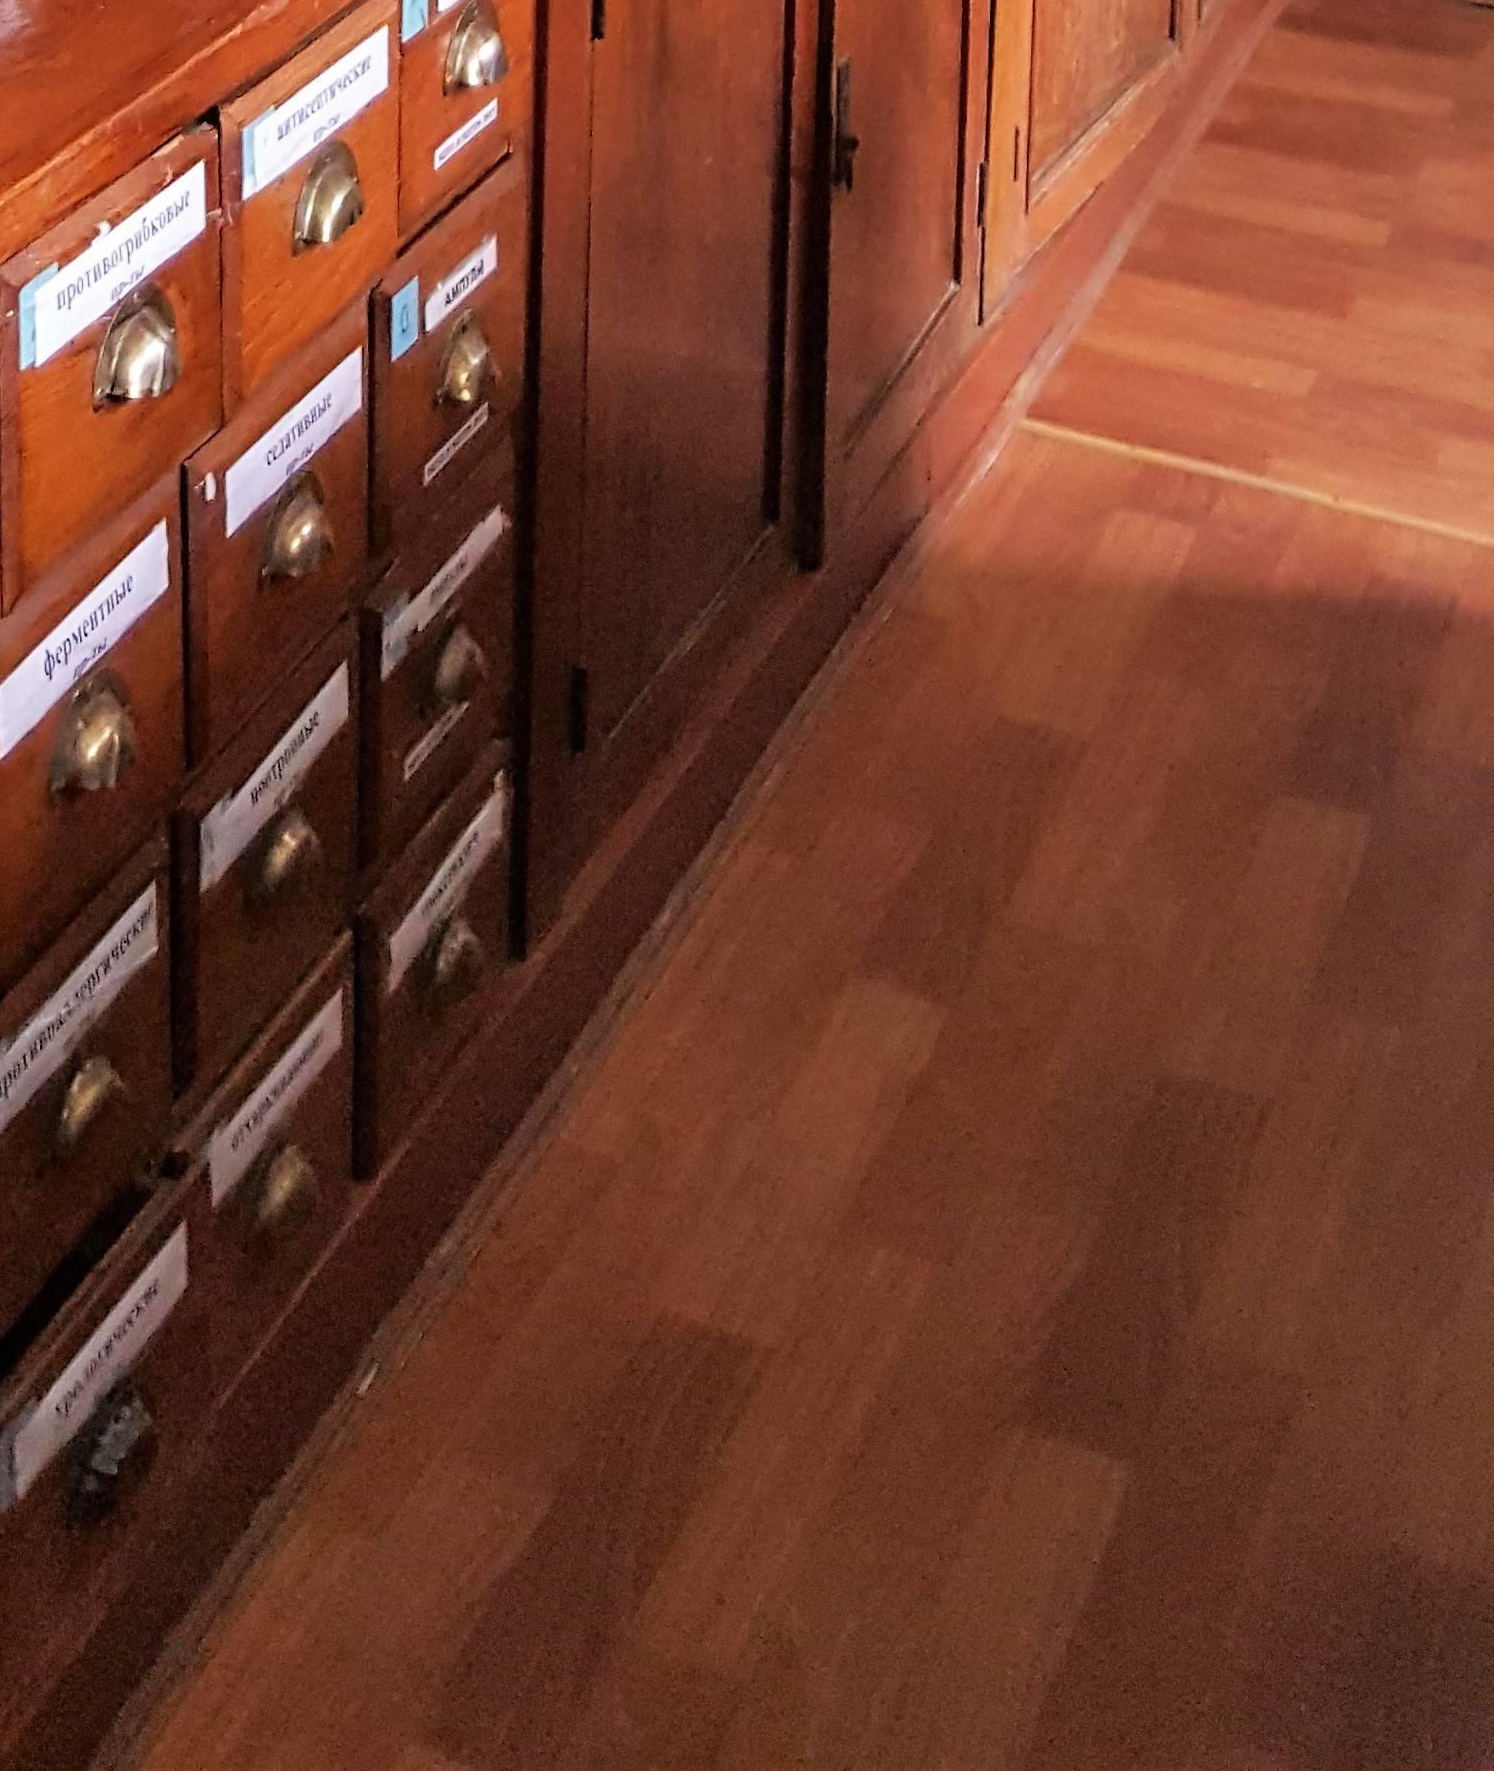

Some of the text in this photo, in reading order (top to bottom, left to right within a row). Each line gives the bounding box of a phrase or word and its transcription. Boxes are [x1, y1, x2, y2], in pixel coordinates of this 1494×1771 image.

[55, 190, 191, 311] противогрибковые
[265, 391, 334, 467] седативные
[42, 574, 134, 682] ферментные
